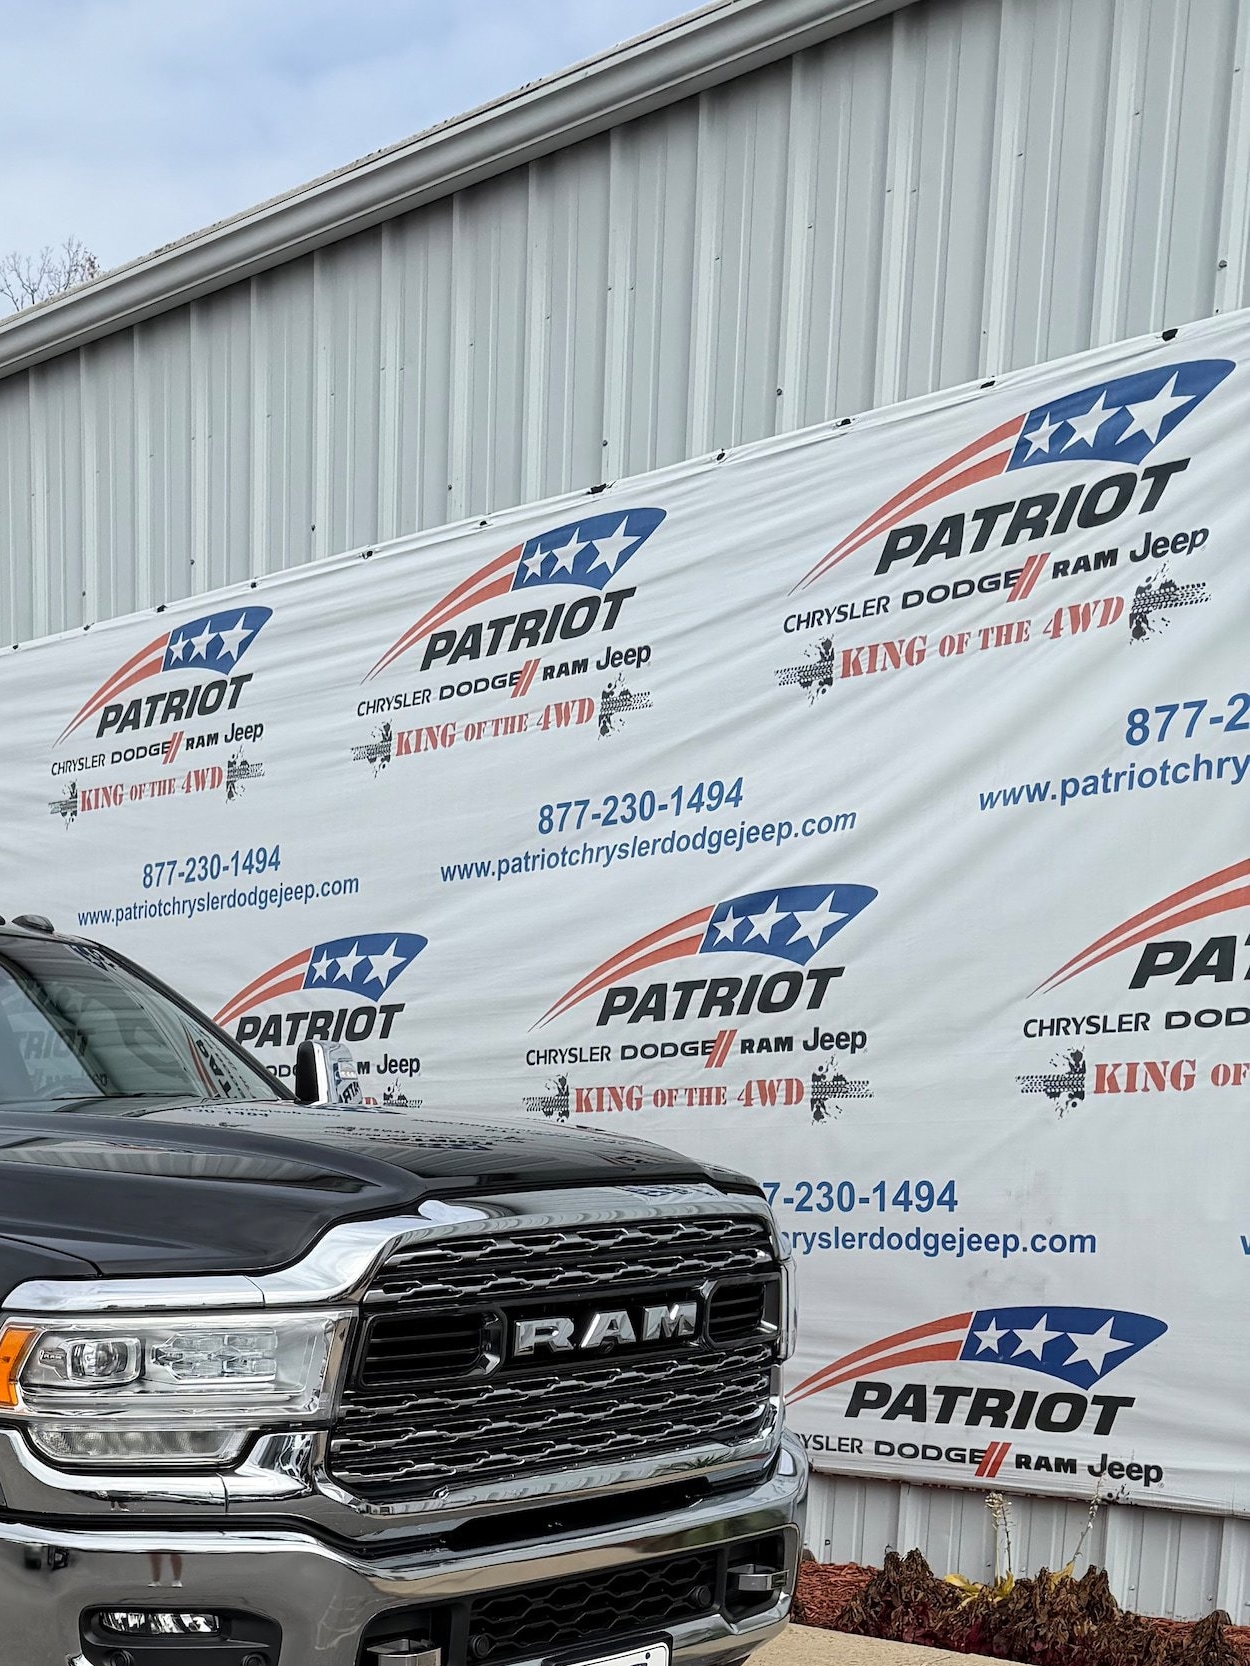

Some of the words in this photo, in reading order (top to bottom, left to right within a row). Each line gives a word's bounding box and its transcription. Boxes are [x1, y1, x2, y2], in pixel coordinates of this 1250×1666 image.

[873, 456, 1192, 577] PATRIOT
[783, 595, 891, 634] CHRYSLER
[901, 571, 1024, 610] DODGE
[1051, 547, 1119, 580] RAM
[1129, 527, 1210, 563] Jeep
[419, 586, 638, 673] PATRIOT
[839, 634, 928, 679] KING
[938, 631, 972, 658] OF
[977, 619, 1032, 651] THE
[1042, 596, 1125, 640] 4WD
[95, 672, 254, 740] PATRIOT
[357, 688, 432, 717] CHRYSLER
[438, 672, 524, 701] DODGE
[541, 657, 589, 682] RAM
[595, 644, 652, 671] Jeep
[51, 753, 106, 777] CHRYSLER
[110, 742, 171, 765] DODGE
[185, 731, 220, 752] RAM
[223, 722, 264, 744] Jeep
[395, 721, 457, 757] KING
[463, 720, 488, 742] OF
[491, 714, 529, 738] THE
[536, 697, 595, 732] 4WD
[80, 783, 124, 813] KING
[129, 782, 147, 801] OF
[148, 777, 176, 798] THE
[181, 766, 224, 794] 4WD
[538, 776, 746, 835] 877-230-1494
[142, 844, 281, 889] 877-230-1494
[440, 811, 857, 883] www.patriotchryslerdodgejeep.com
[77, 877, 359, 927] www.patriotchryslerdodgejeep.com
[595, 966, 846, 1028] PATRIOT
[1022, 1011, 1151, 1039] CHRYSLER
[1164, 1006, 1250, 1031] DOD
[235, 1002, 406, 1049] PATRIOT
[525, 1045, 612, 1067] CHRYSLER
[620, 1040, 715, 1061] DODGE
[740, 1035, 794, 1055] RAM
[802, 1026, 868, 1055] Jeep
[376, 1052, 421, 1078] Jeep
[1092, 1058, 1197, 1095] KING
[1210, 1062, 1250, 1087] OF
[574, 1084, 644, 1113] KING
[652, 1087, 680, 1108] OF
[686, 1085, 727, 1106] THE
[736, 1077, 805, 1108] 4WD
[514, 1302, 698, 1357] RAM
[843, 1380, 1137, 1436] PATRIOT
[874, 1440, 985, 1464] DODGE
[1015, 1453, 1078, 1475] RAM
[1086, 1453, 1164, 1488] Jeep
